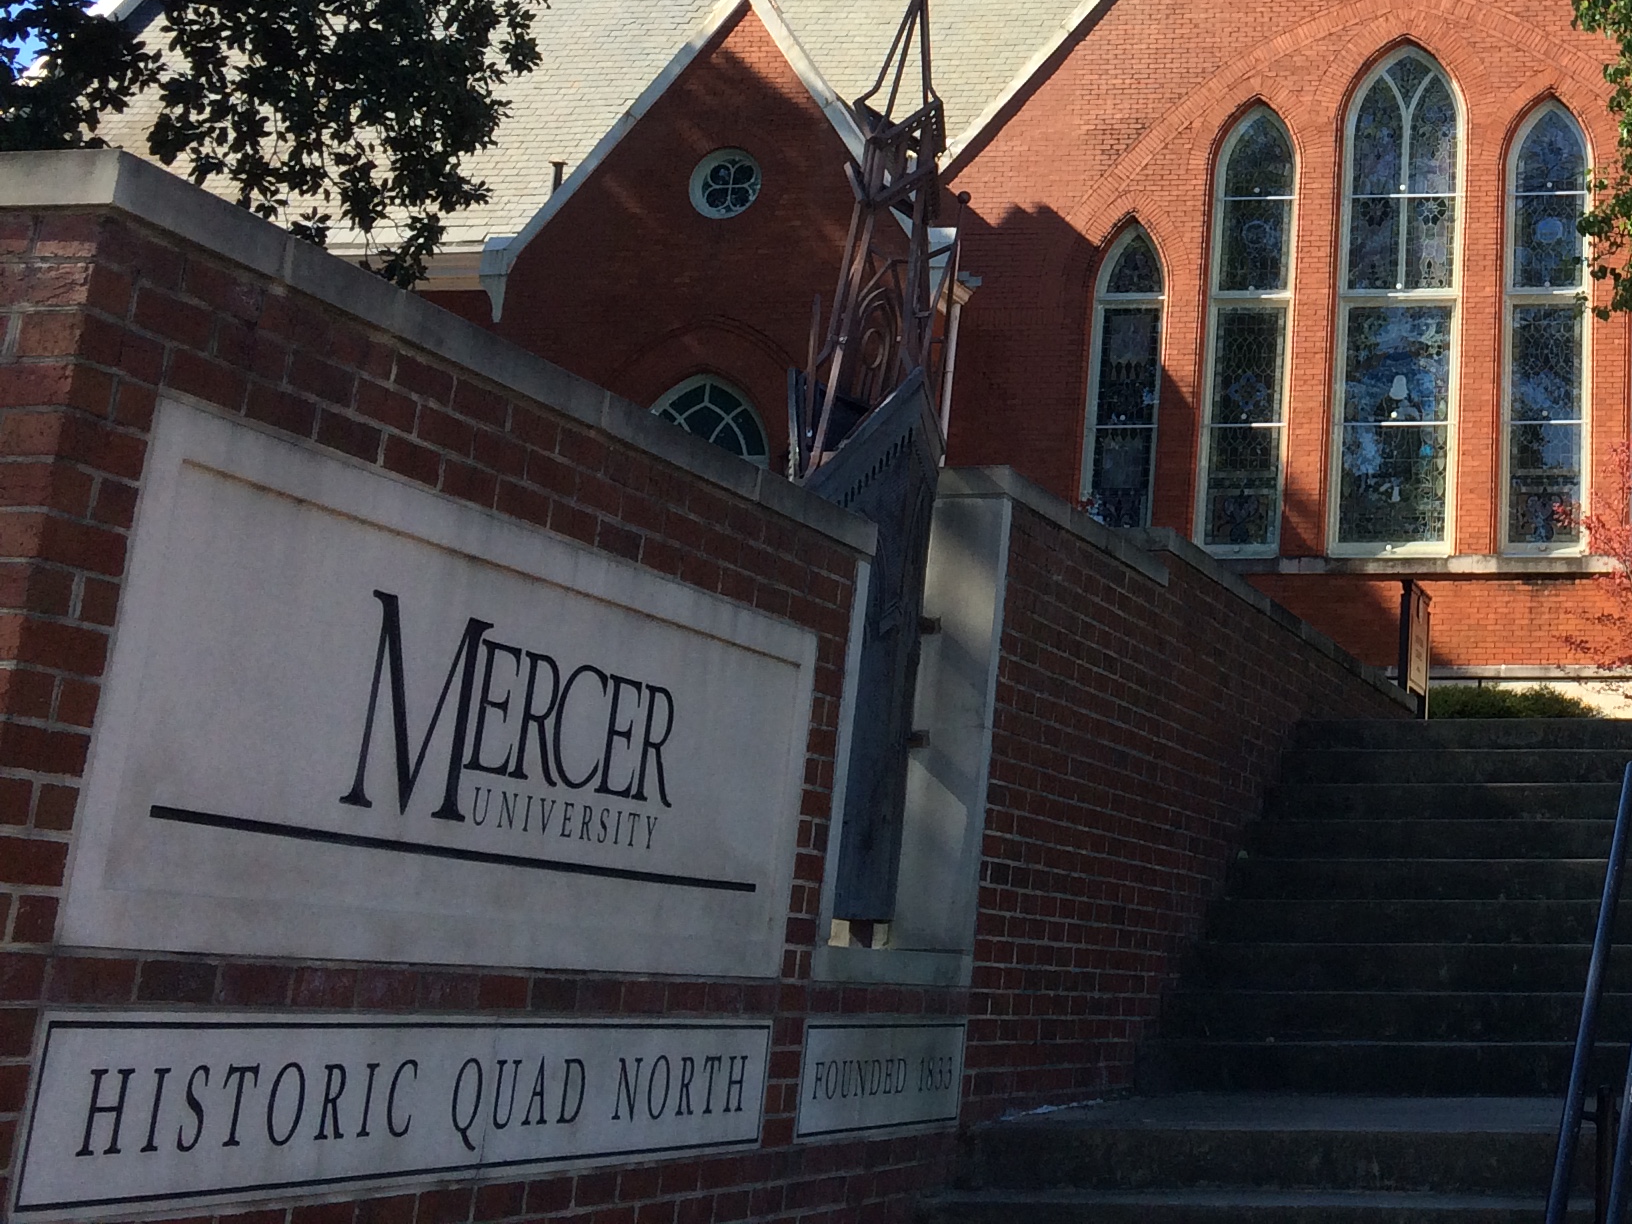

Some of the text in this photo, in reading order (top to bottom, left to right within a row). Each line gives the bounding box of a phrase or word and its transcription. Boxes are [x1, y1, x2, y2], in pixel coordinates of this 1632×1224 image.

[340, 589, 674, 821] MERCER
[473, 786, 659, 849] UNIVERSITY
[76, 1054, 749, 1157] HISTORIC QUAD NORTH
[812, 1056, 954, 1100] FOUNDED 1833
